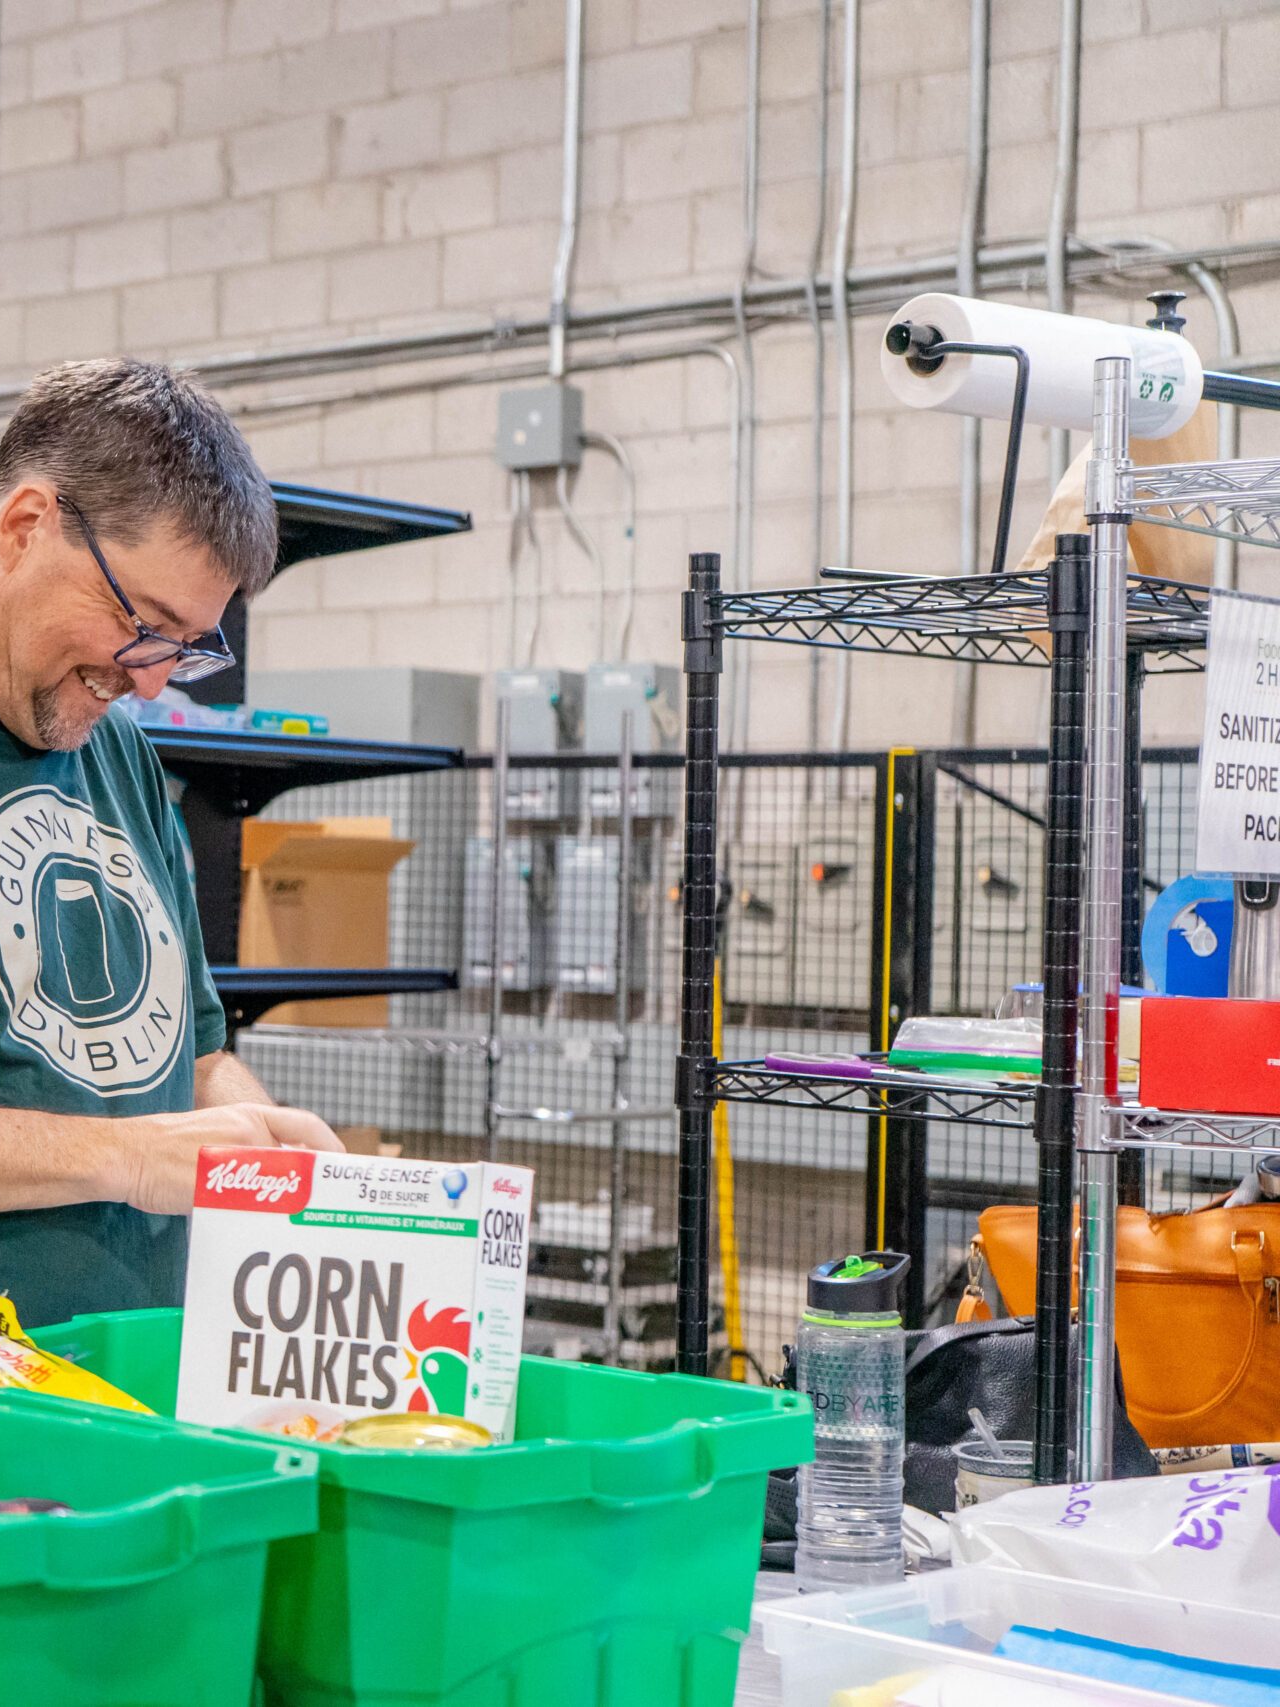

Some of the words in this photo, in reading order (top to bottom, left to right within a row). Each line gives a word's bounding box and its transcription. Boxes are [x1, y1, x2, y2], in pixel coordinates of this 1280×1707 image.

[1256, 661, 1264, 685] 2
[1214, 762, 1279, 793] BEFORE
[1244, 814, 1280, 842] PAC
[17, 997, 173, 1072] DUBLIN
[206, 1159, 301, 1202] Kellogg's
[322, 1164, 375, 1181] SUCRÉ
[358, 1183, 367, 1199] 3
[369, 1189, 377, 1203] g
[380, 1190, 392, 1200] DE
[395, 1191, 430, 1203] SUCRE
[303, 1211, 335, 1223] SOURCE
[336, 1213, 347, 1224] DE
[348, 1214, 354, 1224] 6
[355, 1214, 401, 1227] VITAMINES
[403, 1217, 413, 1228] ET
[415, 1216, 465, 1231] MINÉRAUX
[484, 1208, 525, 1243] CORN
[481, 1240, 522, 1268] FLAKES
[232, 1251, 404, 1342] CORN
[227, 1330, 401, 1411] FLAKES
